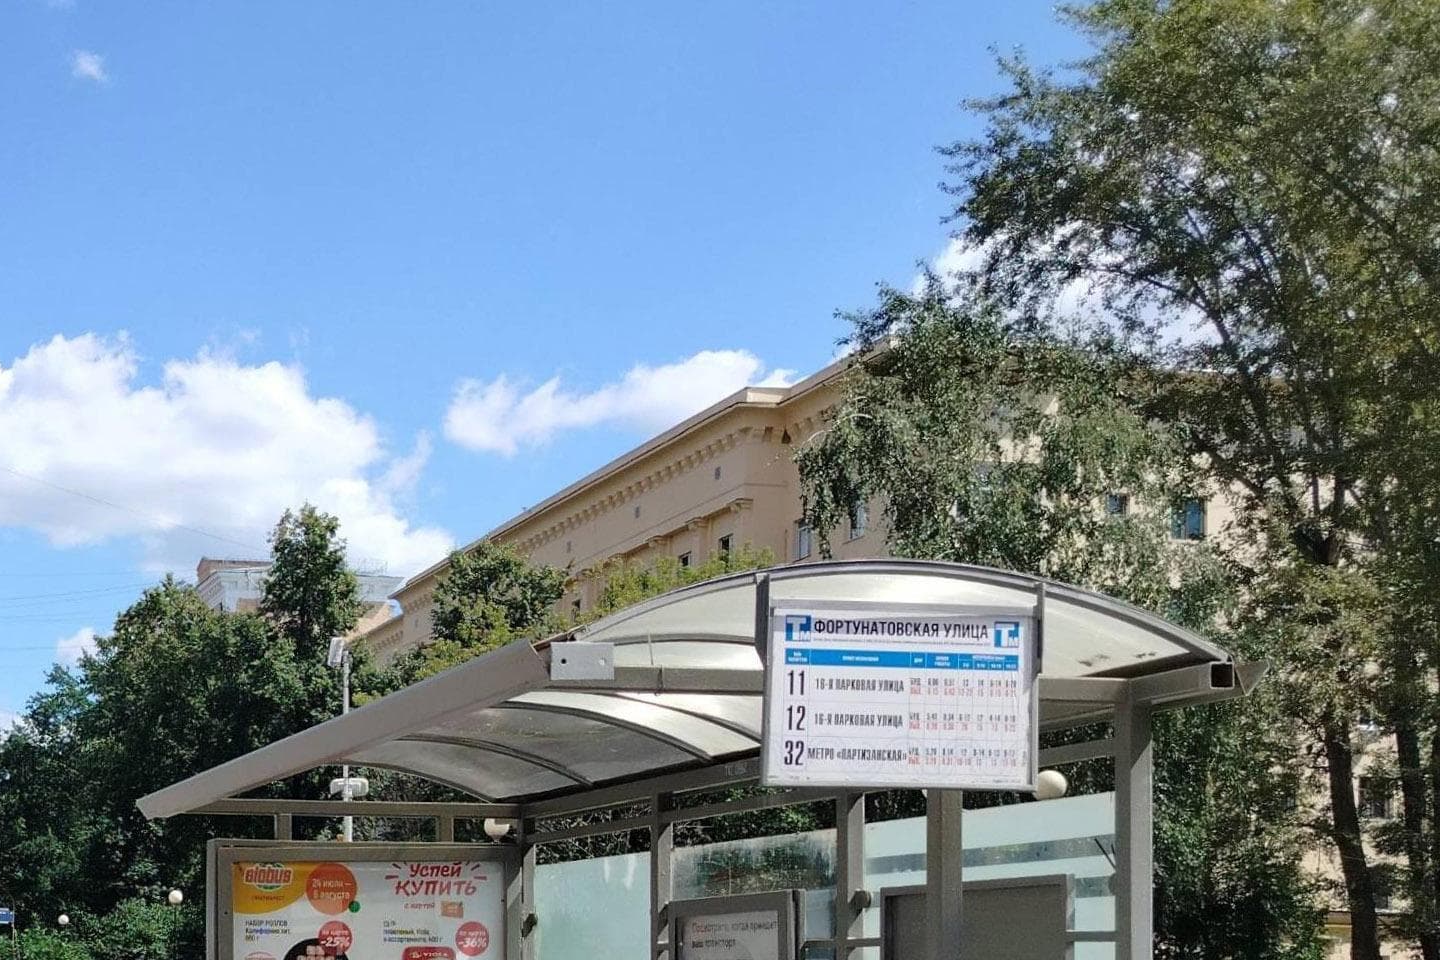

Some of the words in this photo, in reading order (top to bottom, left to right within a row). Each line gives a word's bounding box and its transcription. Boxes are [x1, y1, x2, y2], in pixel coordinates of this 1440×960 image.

[814, 618, 939, 638] ФОРТУНАТОВСКАЯ
[944, 623, 989, 640] УЛИЦА
[788, 670, 805, 695] 11
[835, 679, 877, 691] ПАРКОВАЯ
[877, 680, 905, 692] УЛИЦА
[787, 704, 806, 730] 12
[834, 714, 875, 726] ПАРКОВАЯ
[877, 714, 903, 729] УЛИЦА
[784, 740, 805, 765] 32
[807, 747, 834, 760] МЕТРО
[837, 748, 907, 761] «ПАРТИЗАНСКАЯ»
[409, 861, 463, 877] Успей
[323, 880, 344, 888] июля
[395, 880, 478, 896] КУПИТЬ
[321, 892, 350, 900] августа
